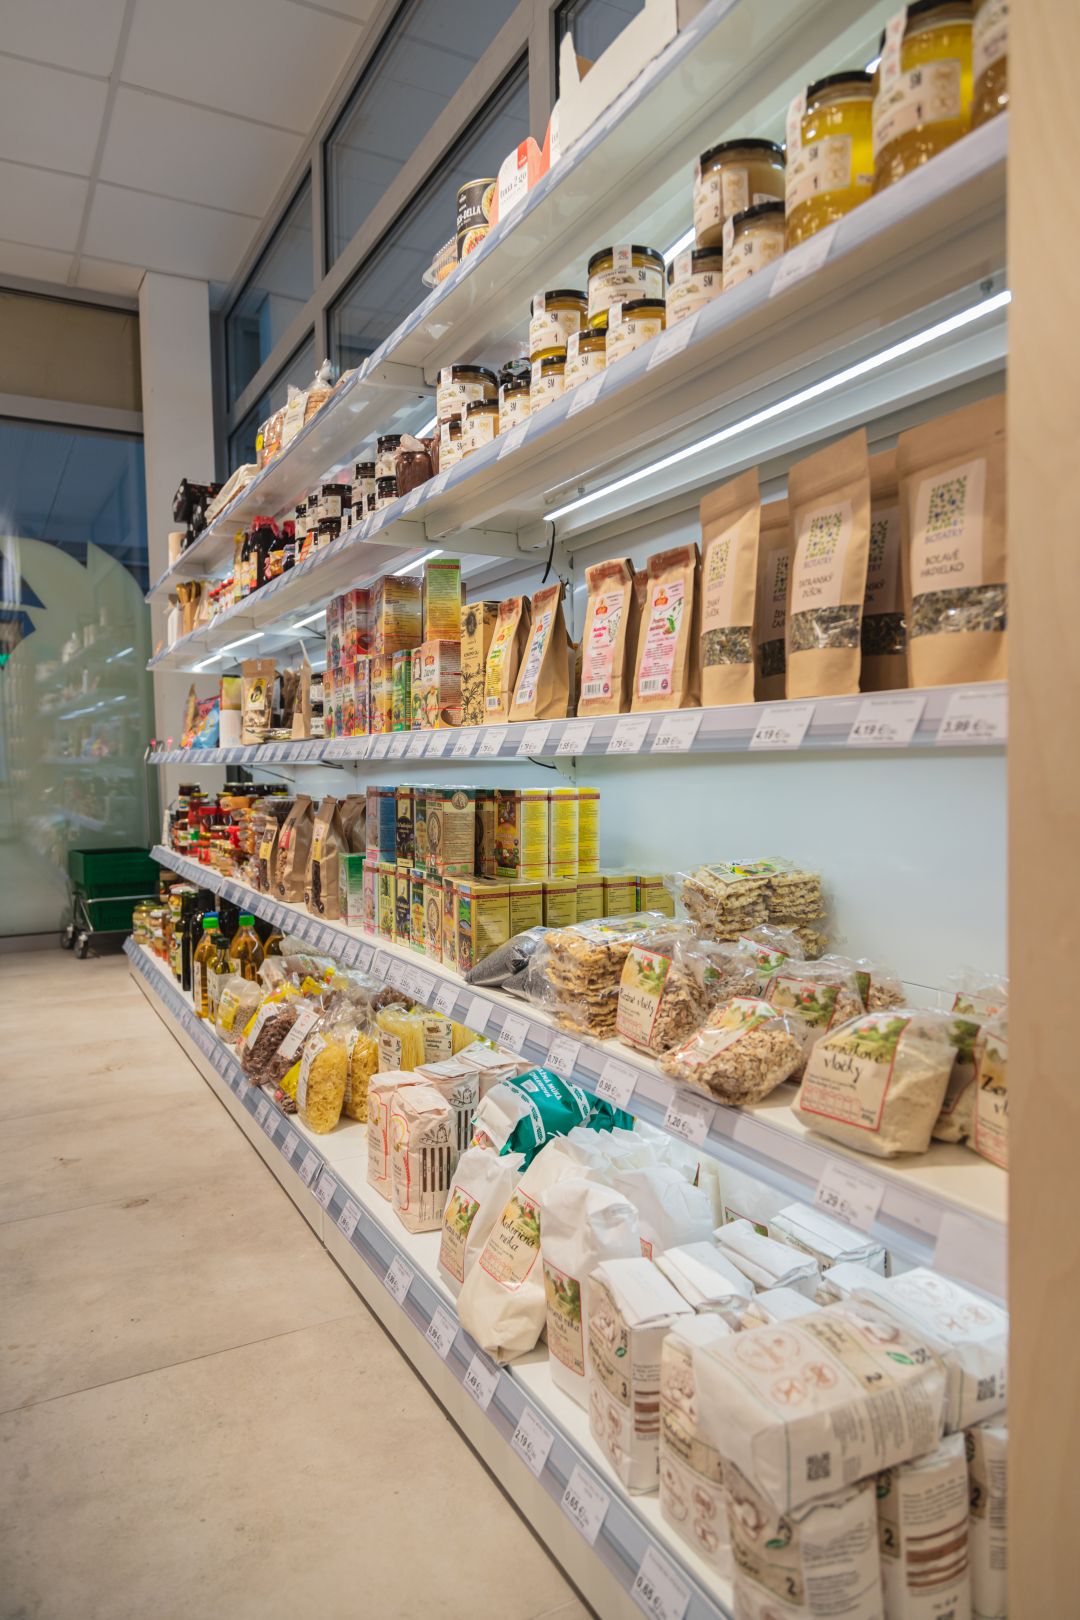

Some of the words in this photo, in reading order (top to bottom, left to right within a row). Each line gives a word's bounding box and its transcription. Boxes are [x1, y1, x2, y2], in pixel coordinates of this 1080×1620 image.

[910, 71, 922, 89] SM
[809, 147, 818, 161] SM
[713, 206, 719, 218] 2
[744, 243, 753, 256] SM
[638, 270, 647, 281] SM
[703, 275, 713, 287] SM
[551, 313, 558, 323] SM
[628, 324, 636, 335] SM
[582, 356, 589, 366] SM
[548, 378, 555, 388] SM
[459, 385, 466, 394] SM
[510, 401, 517, 411] SM
[823, 1054, 864, 1084] vločky
[621, 1381, 628, 1398] 3
[971, 1487, 981, 1508] 2
[884, 1528, 895, 1547] 2
[786, 1576, 798, 1597] 2
